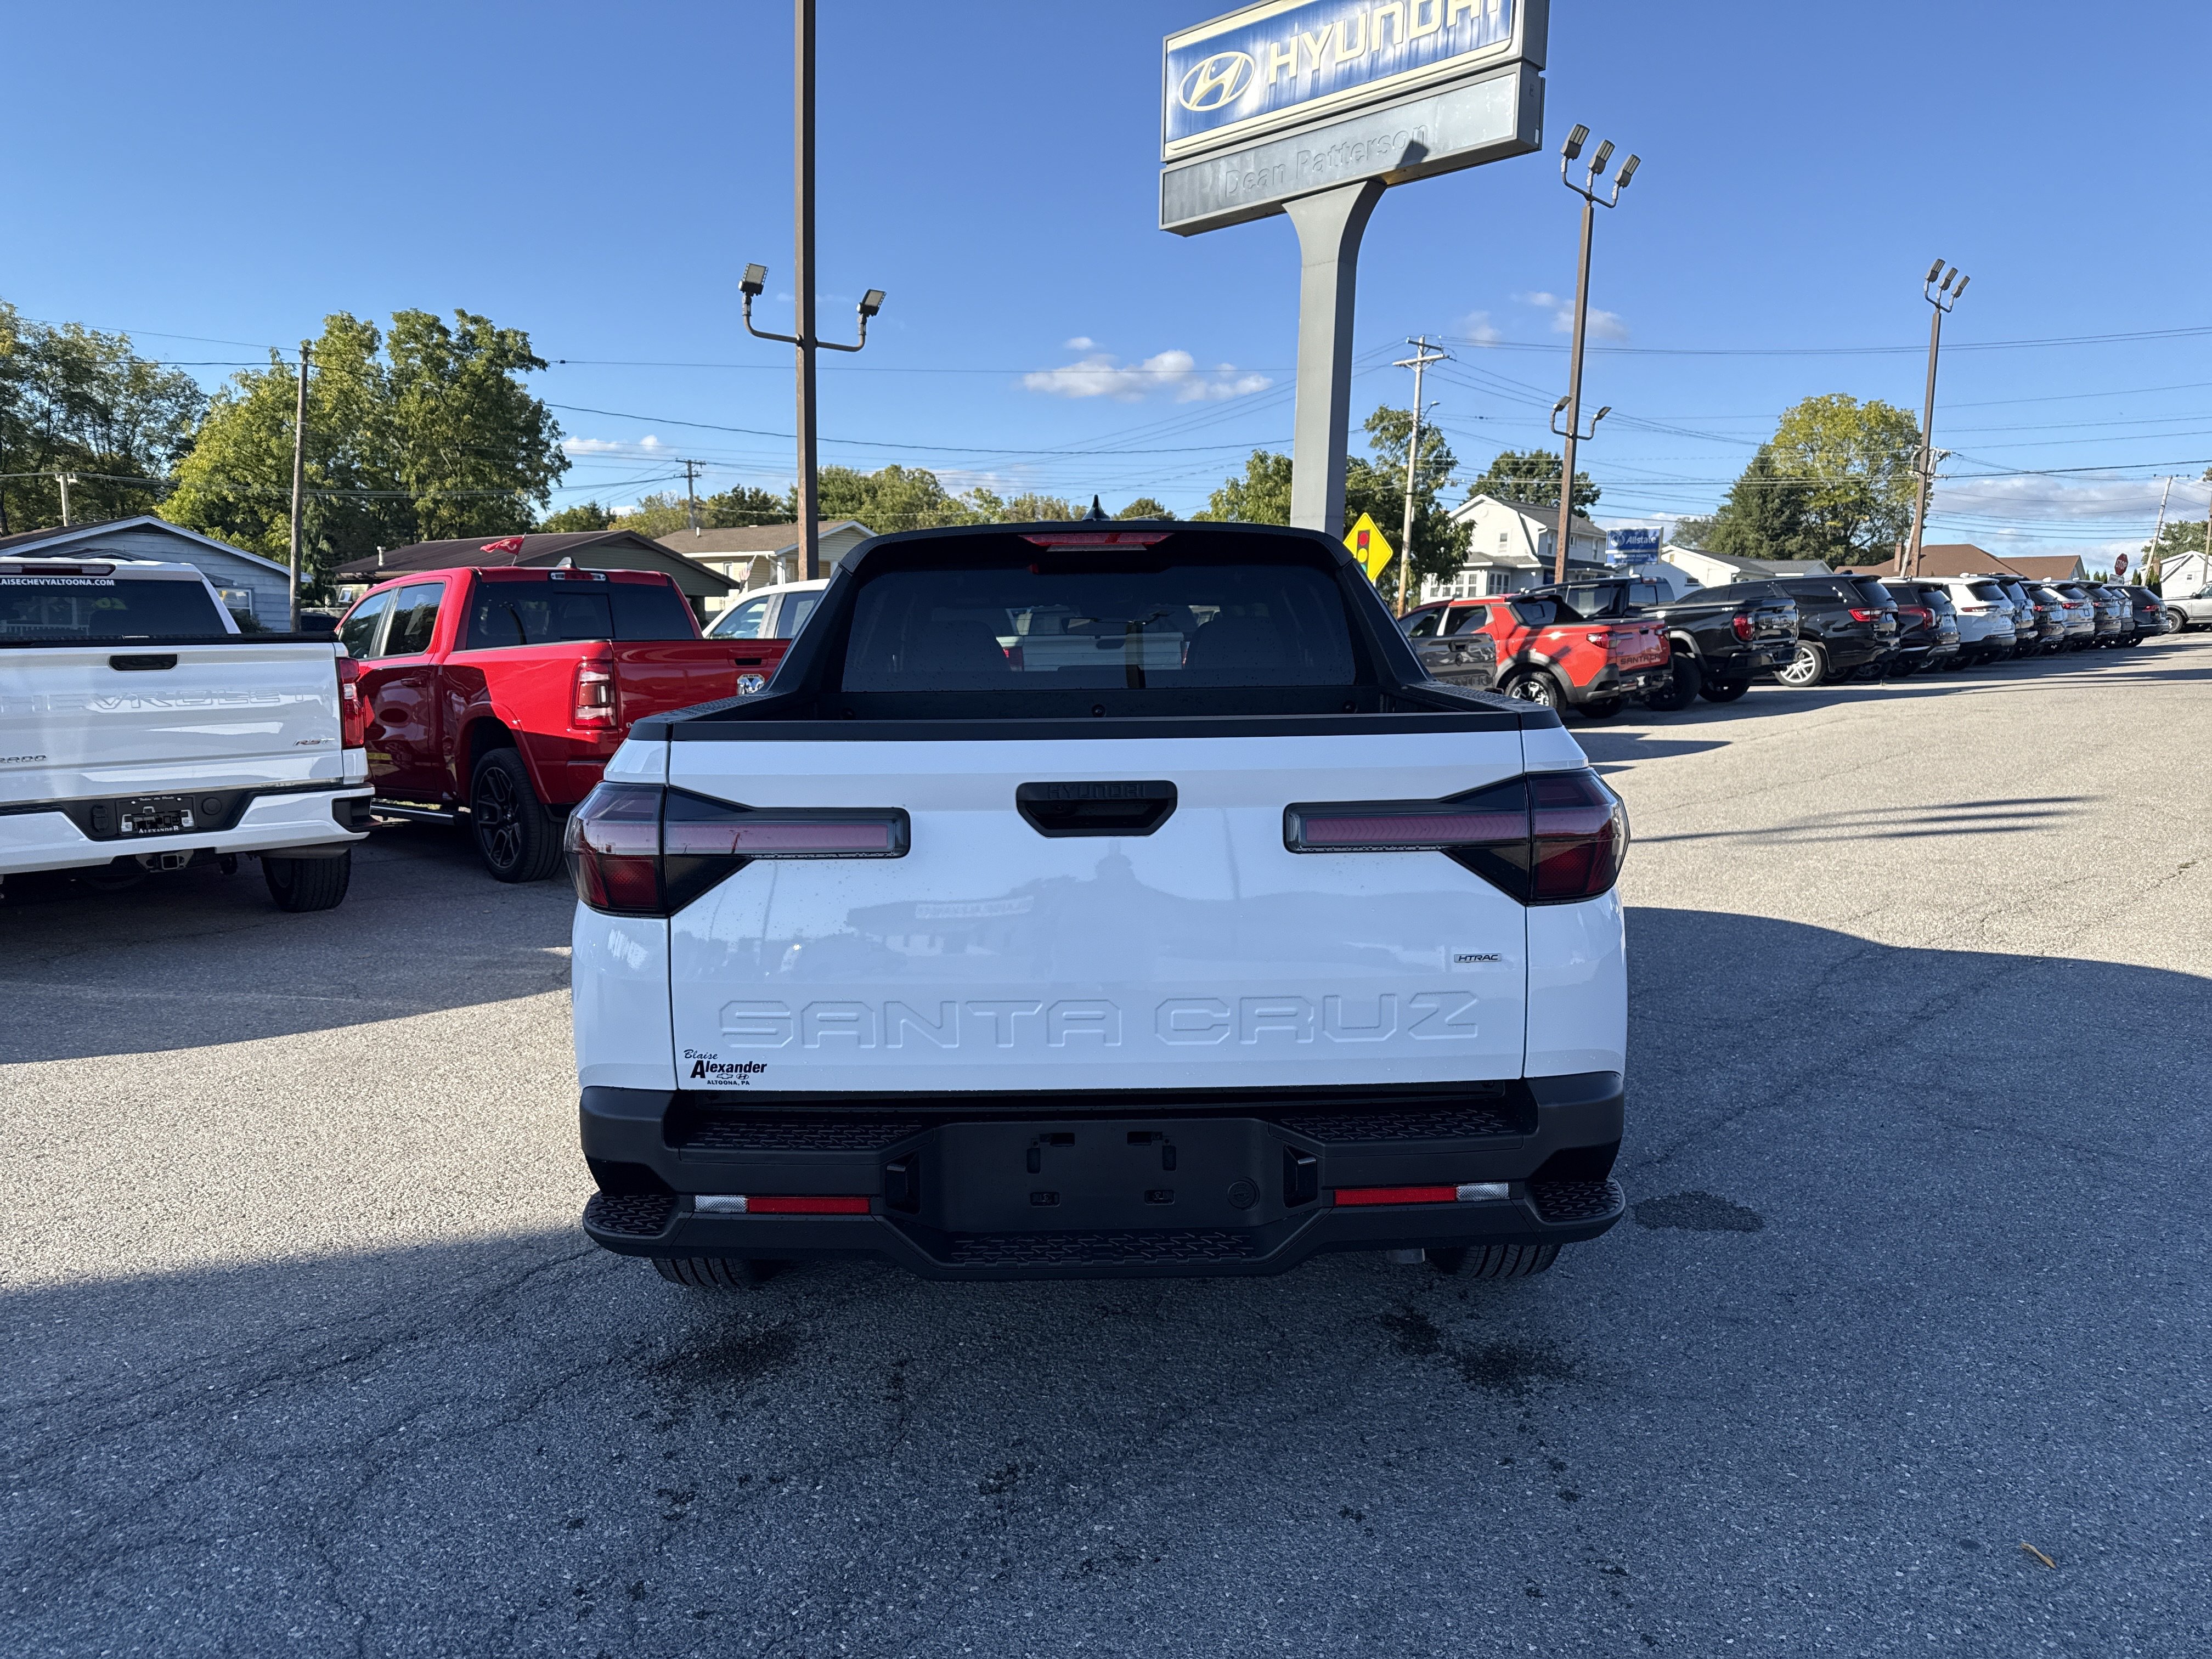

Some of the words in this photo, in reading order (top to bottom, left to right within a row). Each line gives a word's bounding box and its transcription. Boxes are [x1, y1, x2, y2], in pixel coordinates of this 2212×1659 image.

[1269, 0, 1498, 84] HYUNDA
[1224, 163, 1284, 198] Dean
[1296, 125, 1428, 179] Patterson
[1626, 535, 1656, 544] Allstate
[2115, 559, 2127, 570] STOP
[0, 578, 115, 586] AISECHEVYALTOONA.COM
[1621, 656, 1649, 664] SANTA
[1048, 783, 1146, 799] HYUNDAI
[719, 998, 1122, 1048] SANTA
[1155, 990, 1479, 1046] CRUZ
[683, 1049, 718, 1059] Blaise
[690, 1059, 768, 1079] Alexander
